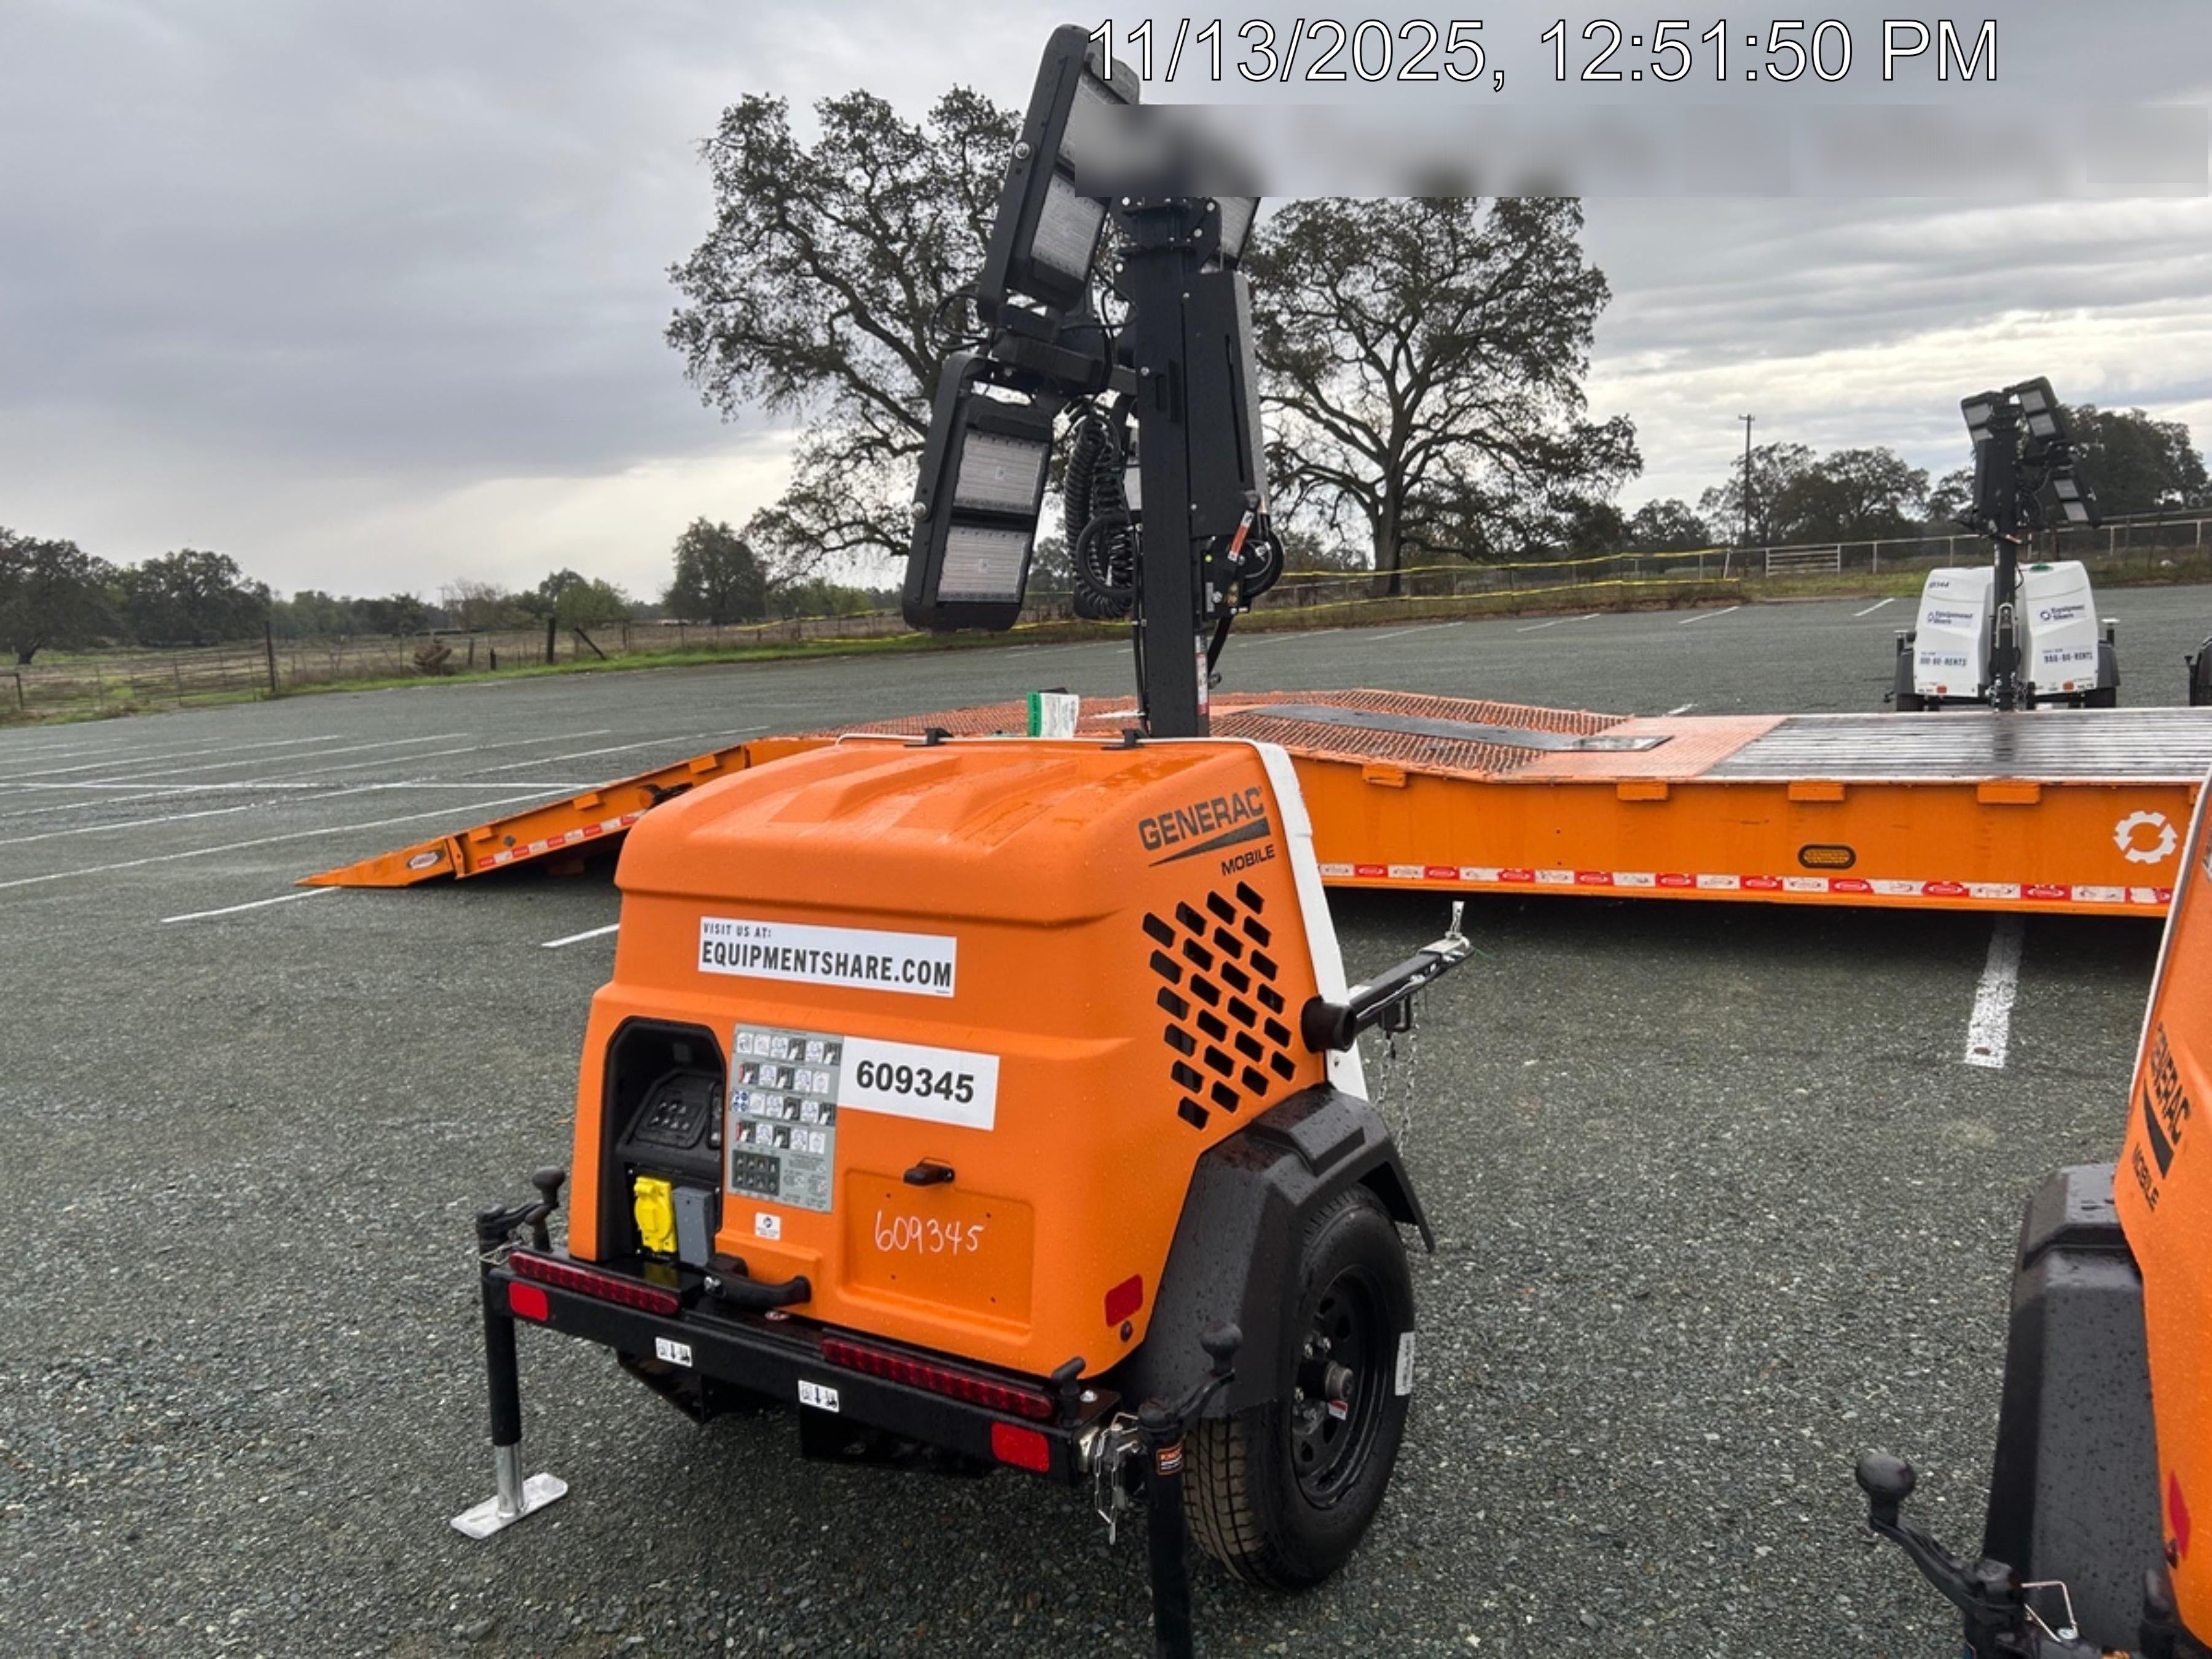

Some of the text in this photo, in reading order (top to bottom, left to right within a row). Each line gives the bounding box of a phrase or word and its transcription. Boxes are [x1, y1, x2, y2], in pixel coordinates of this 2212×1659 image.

[1138, 786, 1265, 850] GENERAC
[1220, 844, 1276, 876] MOBILE
[703, 923, 772, 939] VISIT US AT:
[702, 940, 952, 987] EQUIPMENTSHARE.COM
[856, 1059, 975, 1104] 609345
[874, 1209, 985, 1255] 609345
